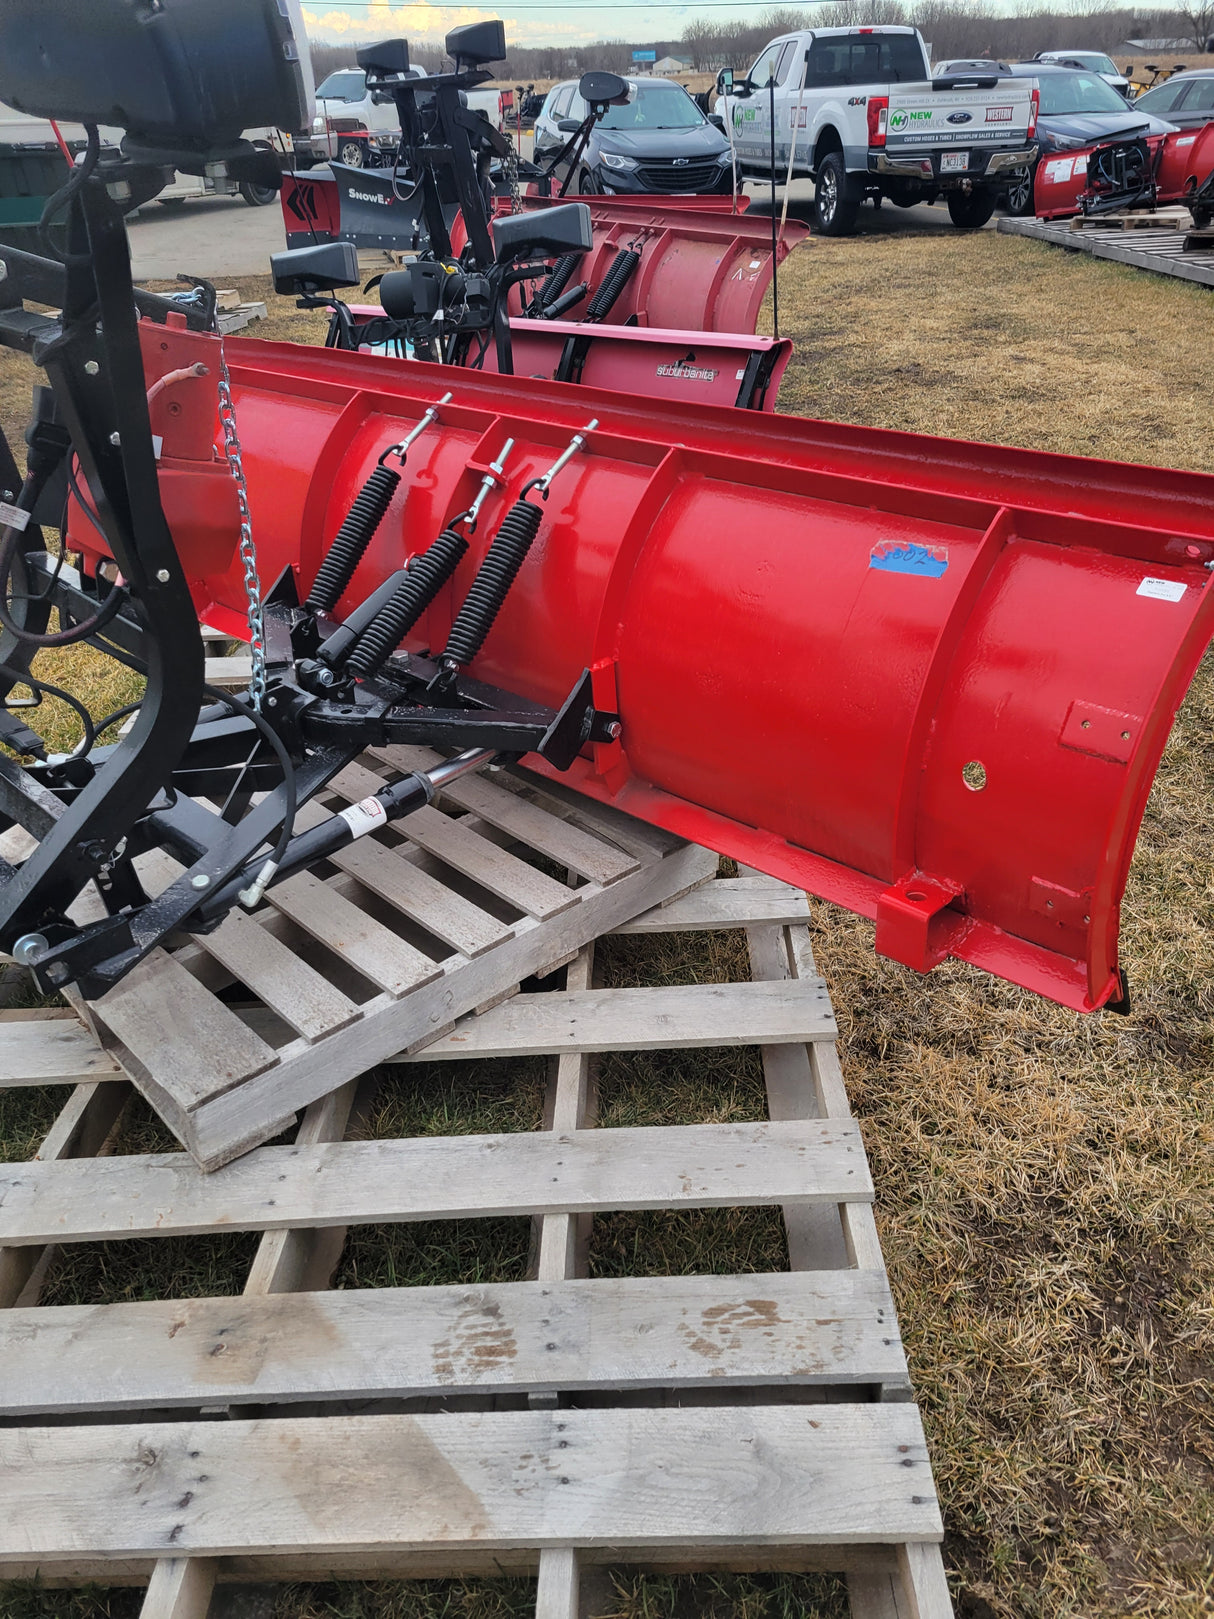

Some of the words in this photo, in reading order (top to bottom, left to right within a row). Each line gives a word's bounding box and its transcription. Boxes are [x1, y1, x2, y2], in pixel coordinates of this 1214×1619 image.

[910, 111, 933, 120] NEW
[987, 108, 1012, 121] WESTERN
[909, 118, 945, 129] HYDRAULICS
[904, 135, 922, 143] CUSTOM
[656, 364, 715, 381] suburbanite
